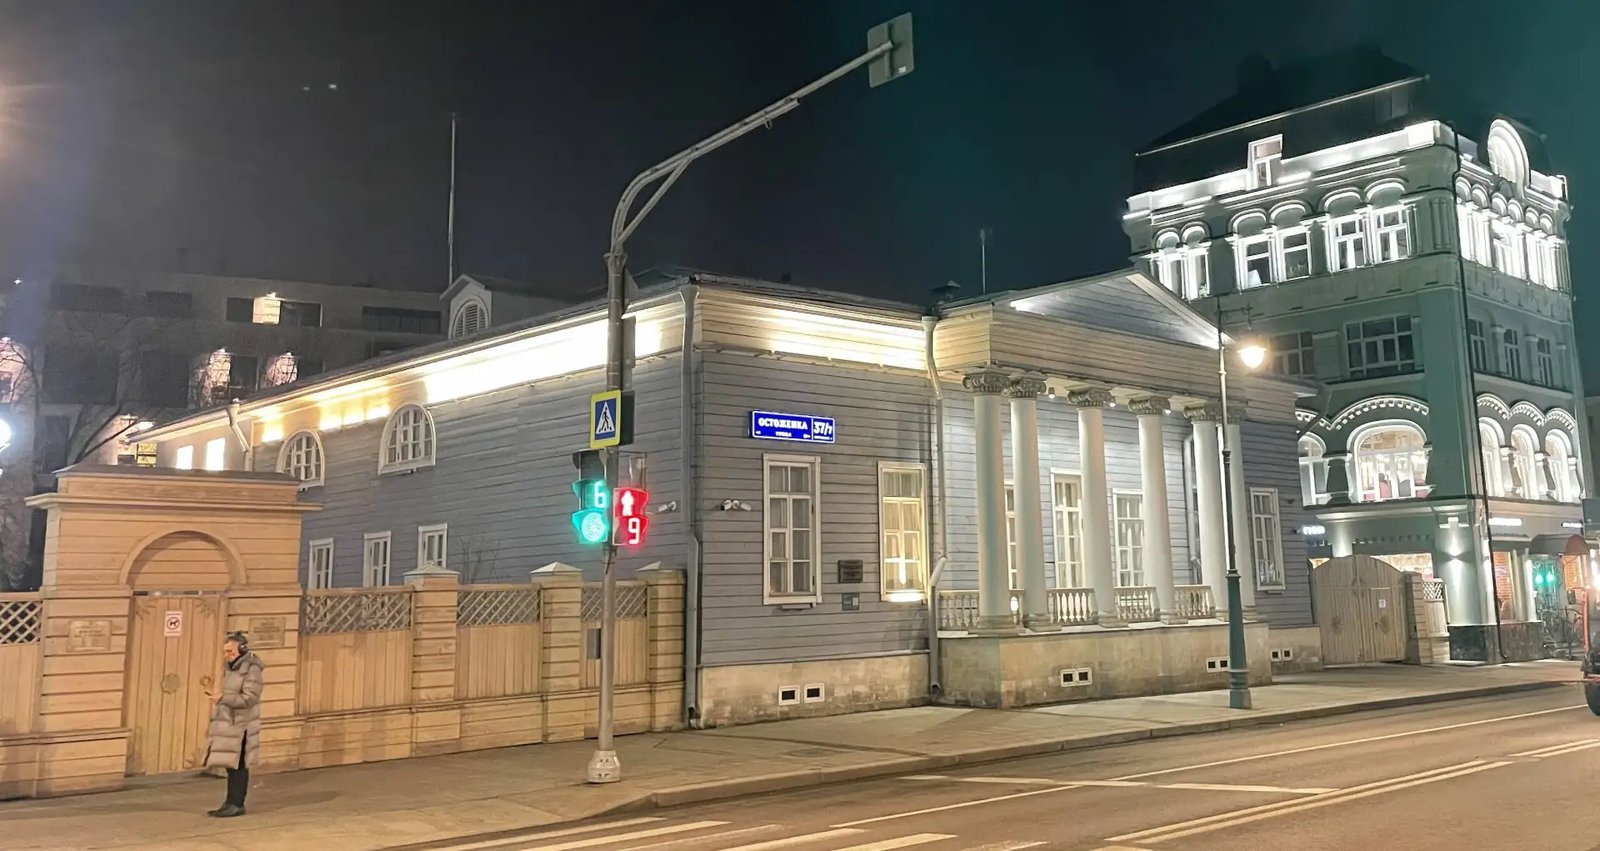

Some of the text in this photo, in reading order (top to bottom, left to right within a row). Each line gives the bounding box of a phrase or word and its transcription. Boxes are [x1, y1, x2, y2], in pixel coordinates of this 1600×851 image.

[758, 417, 808, 430] ОСТОЖЕНКА
[813, 421, 833, 435] 37/7
[594, 480, 607, 508] 6
[628, 517, 640, 544] 9
